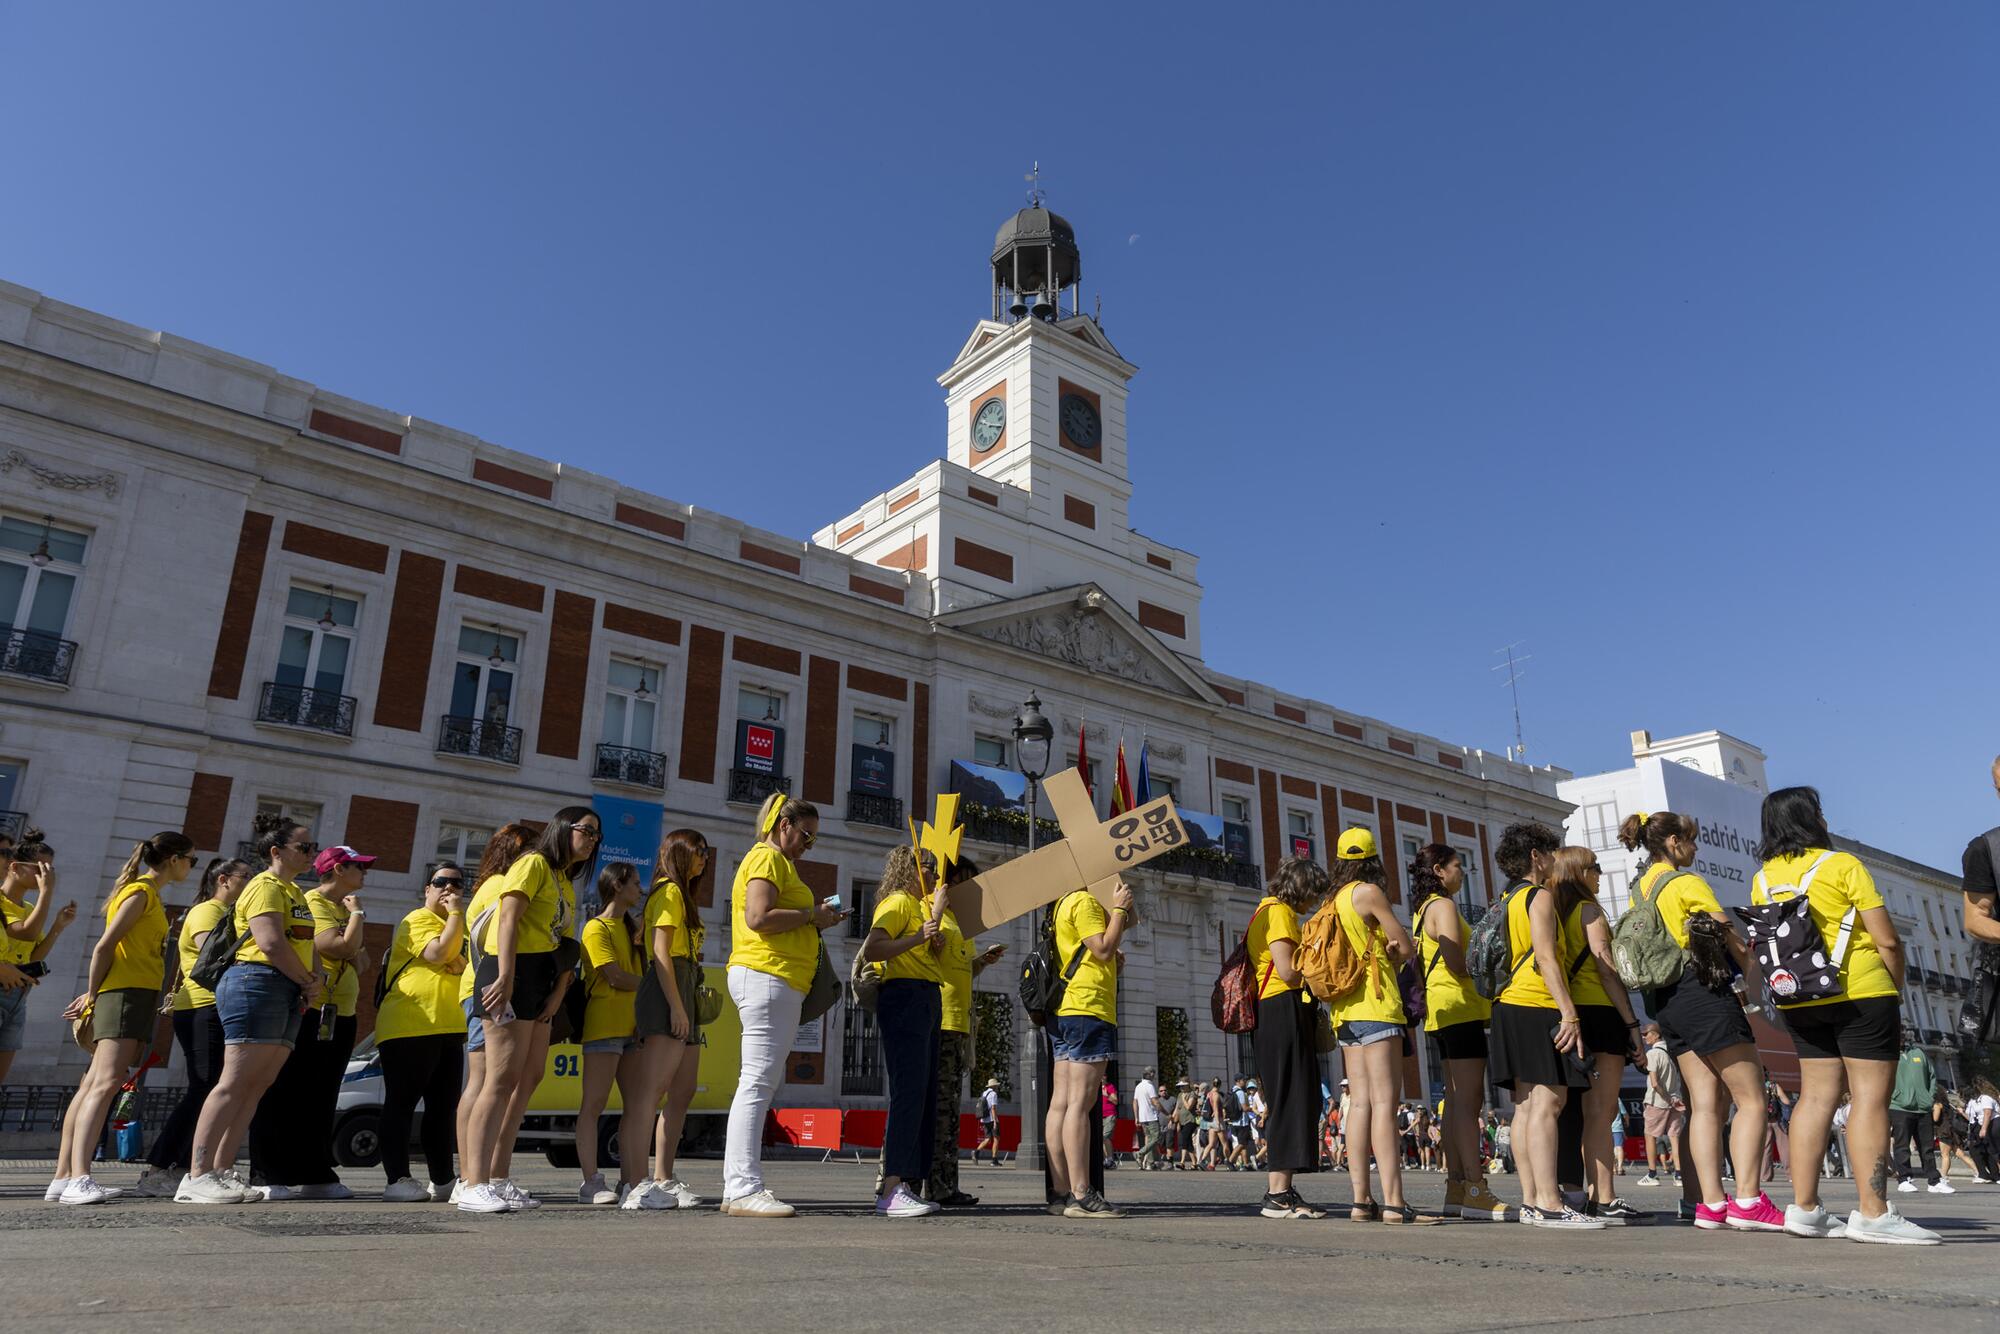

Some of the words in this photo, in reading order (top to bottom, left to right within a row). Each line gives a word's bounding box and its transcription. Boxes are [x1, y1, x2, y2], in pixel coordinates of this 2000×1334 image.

[745, 756, 773, 766] Comunidad
[753, 763, 773, 772] Madrid
[1143, 804, 1182, 845] DEP
[554, 1054, 579, 1077] 91
